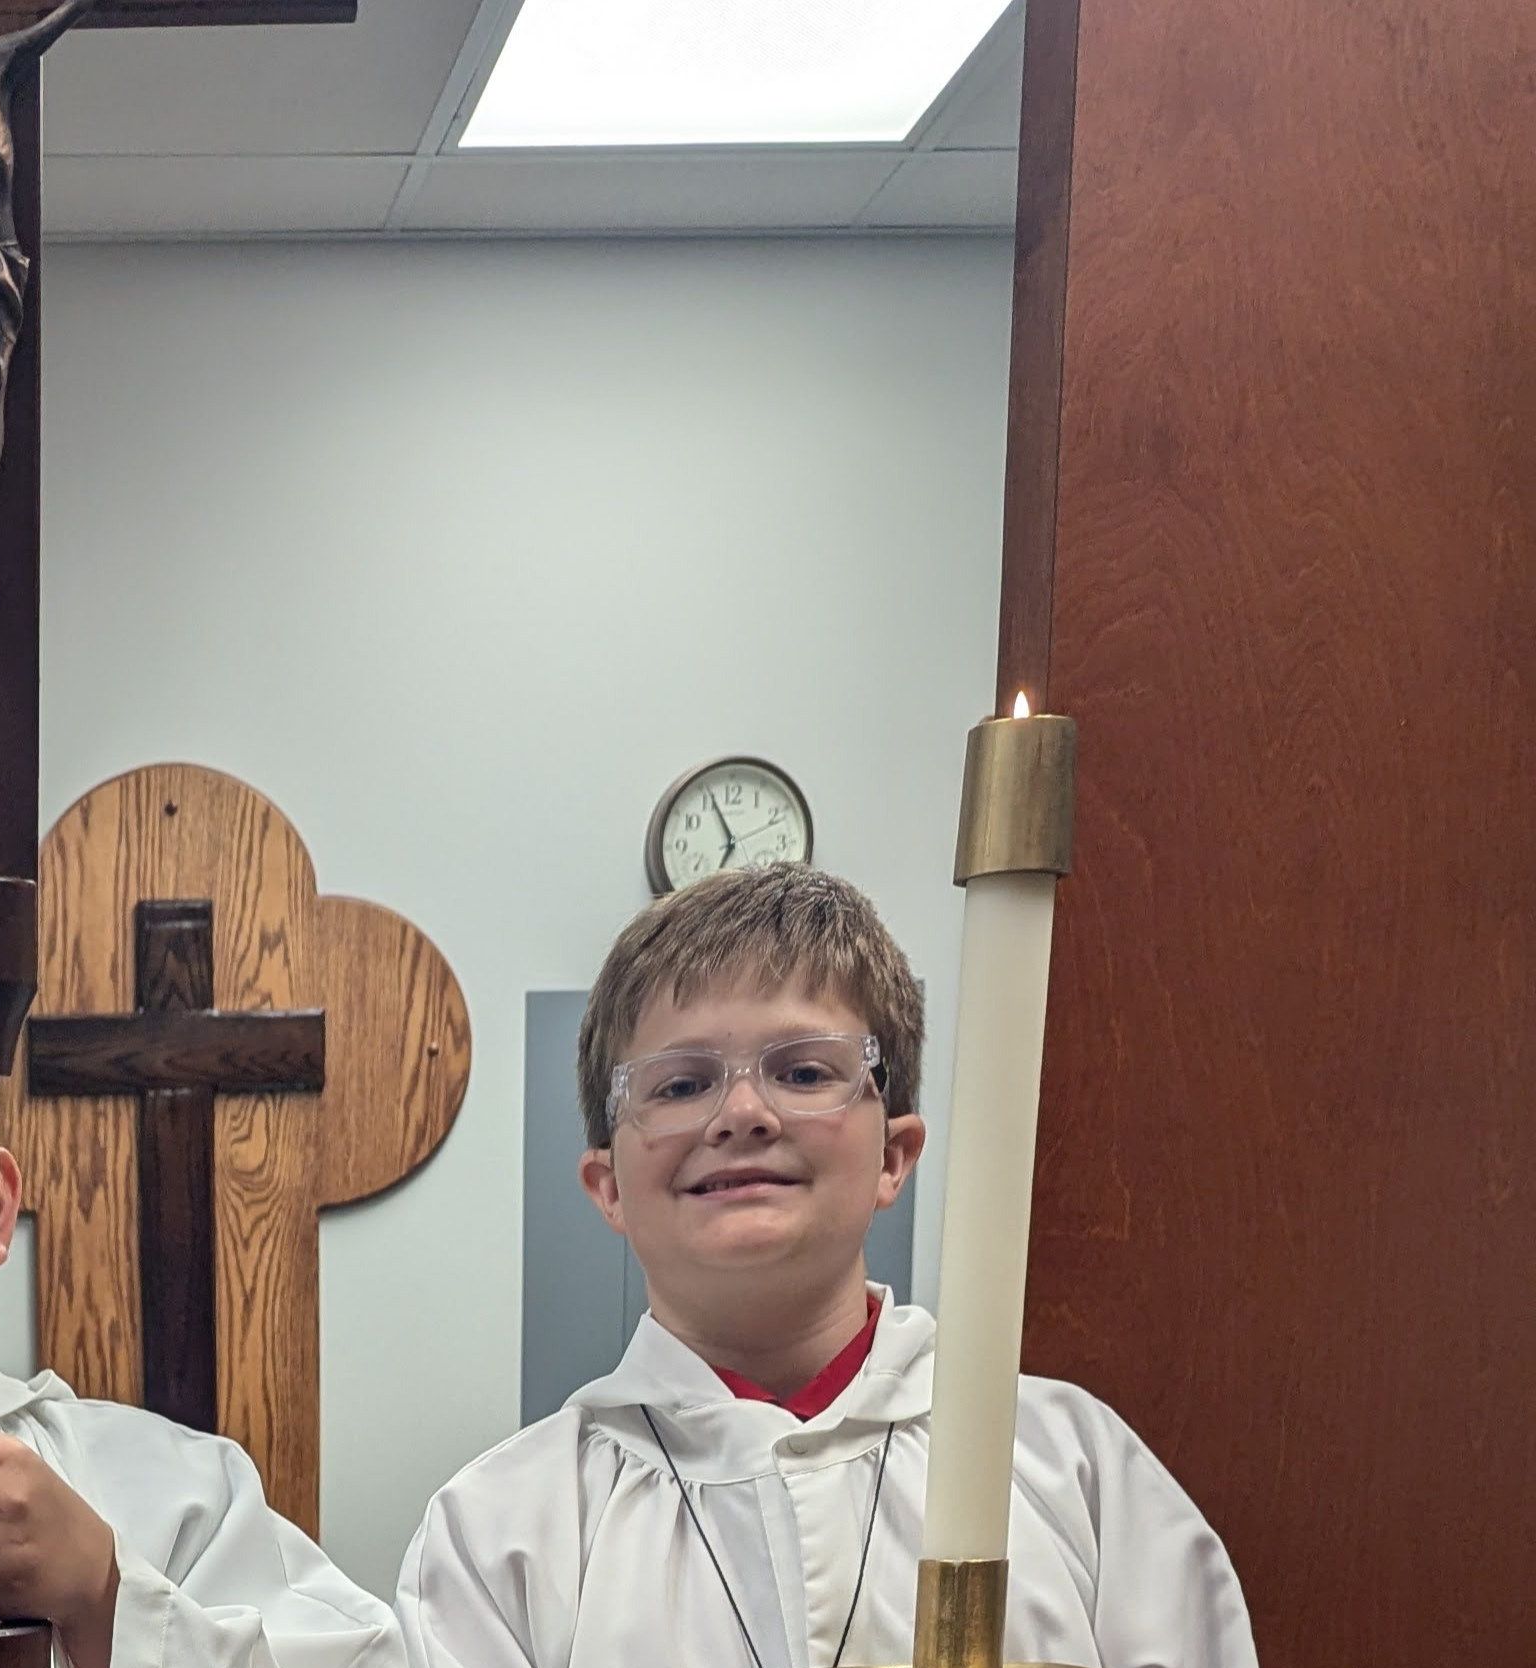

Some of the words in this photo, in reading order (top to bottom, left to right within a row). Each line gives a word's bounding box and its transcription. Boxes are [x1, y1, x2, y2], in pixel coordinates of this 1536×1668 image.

[725, 785, 742, 805] 12
[685, 814, 701, 831] 10
[768, 808, 781, 825] 2
[675, 839, 688, 854] 9
[776, 834, 786, 851] 3
